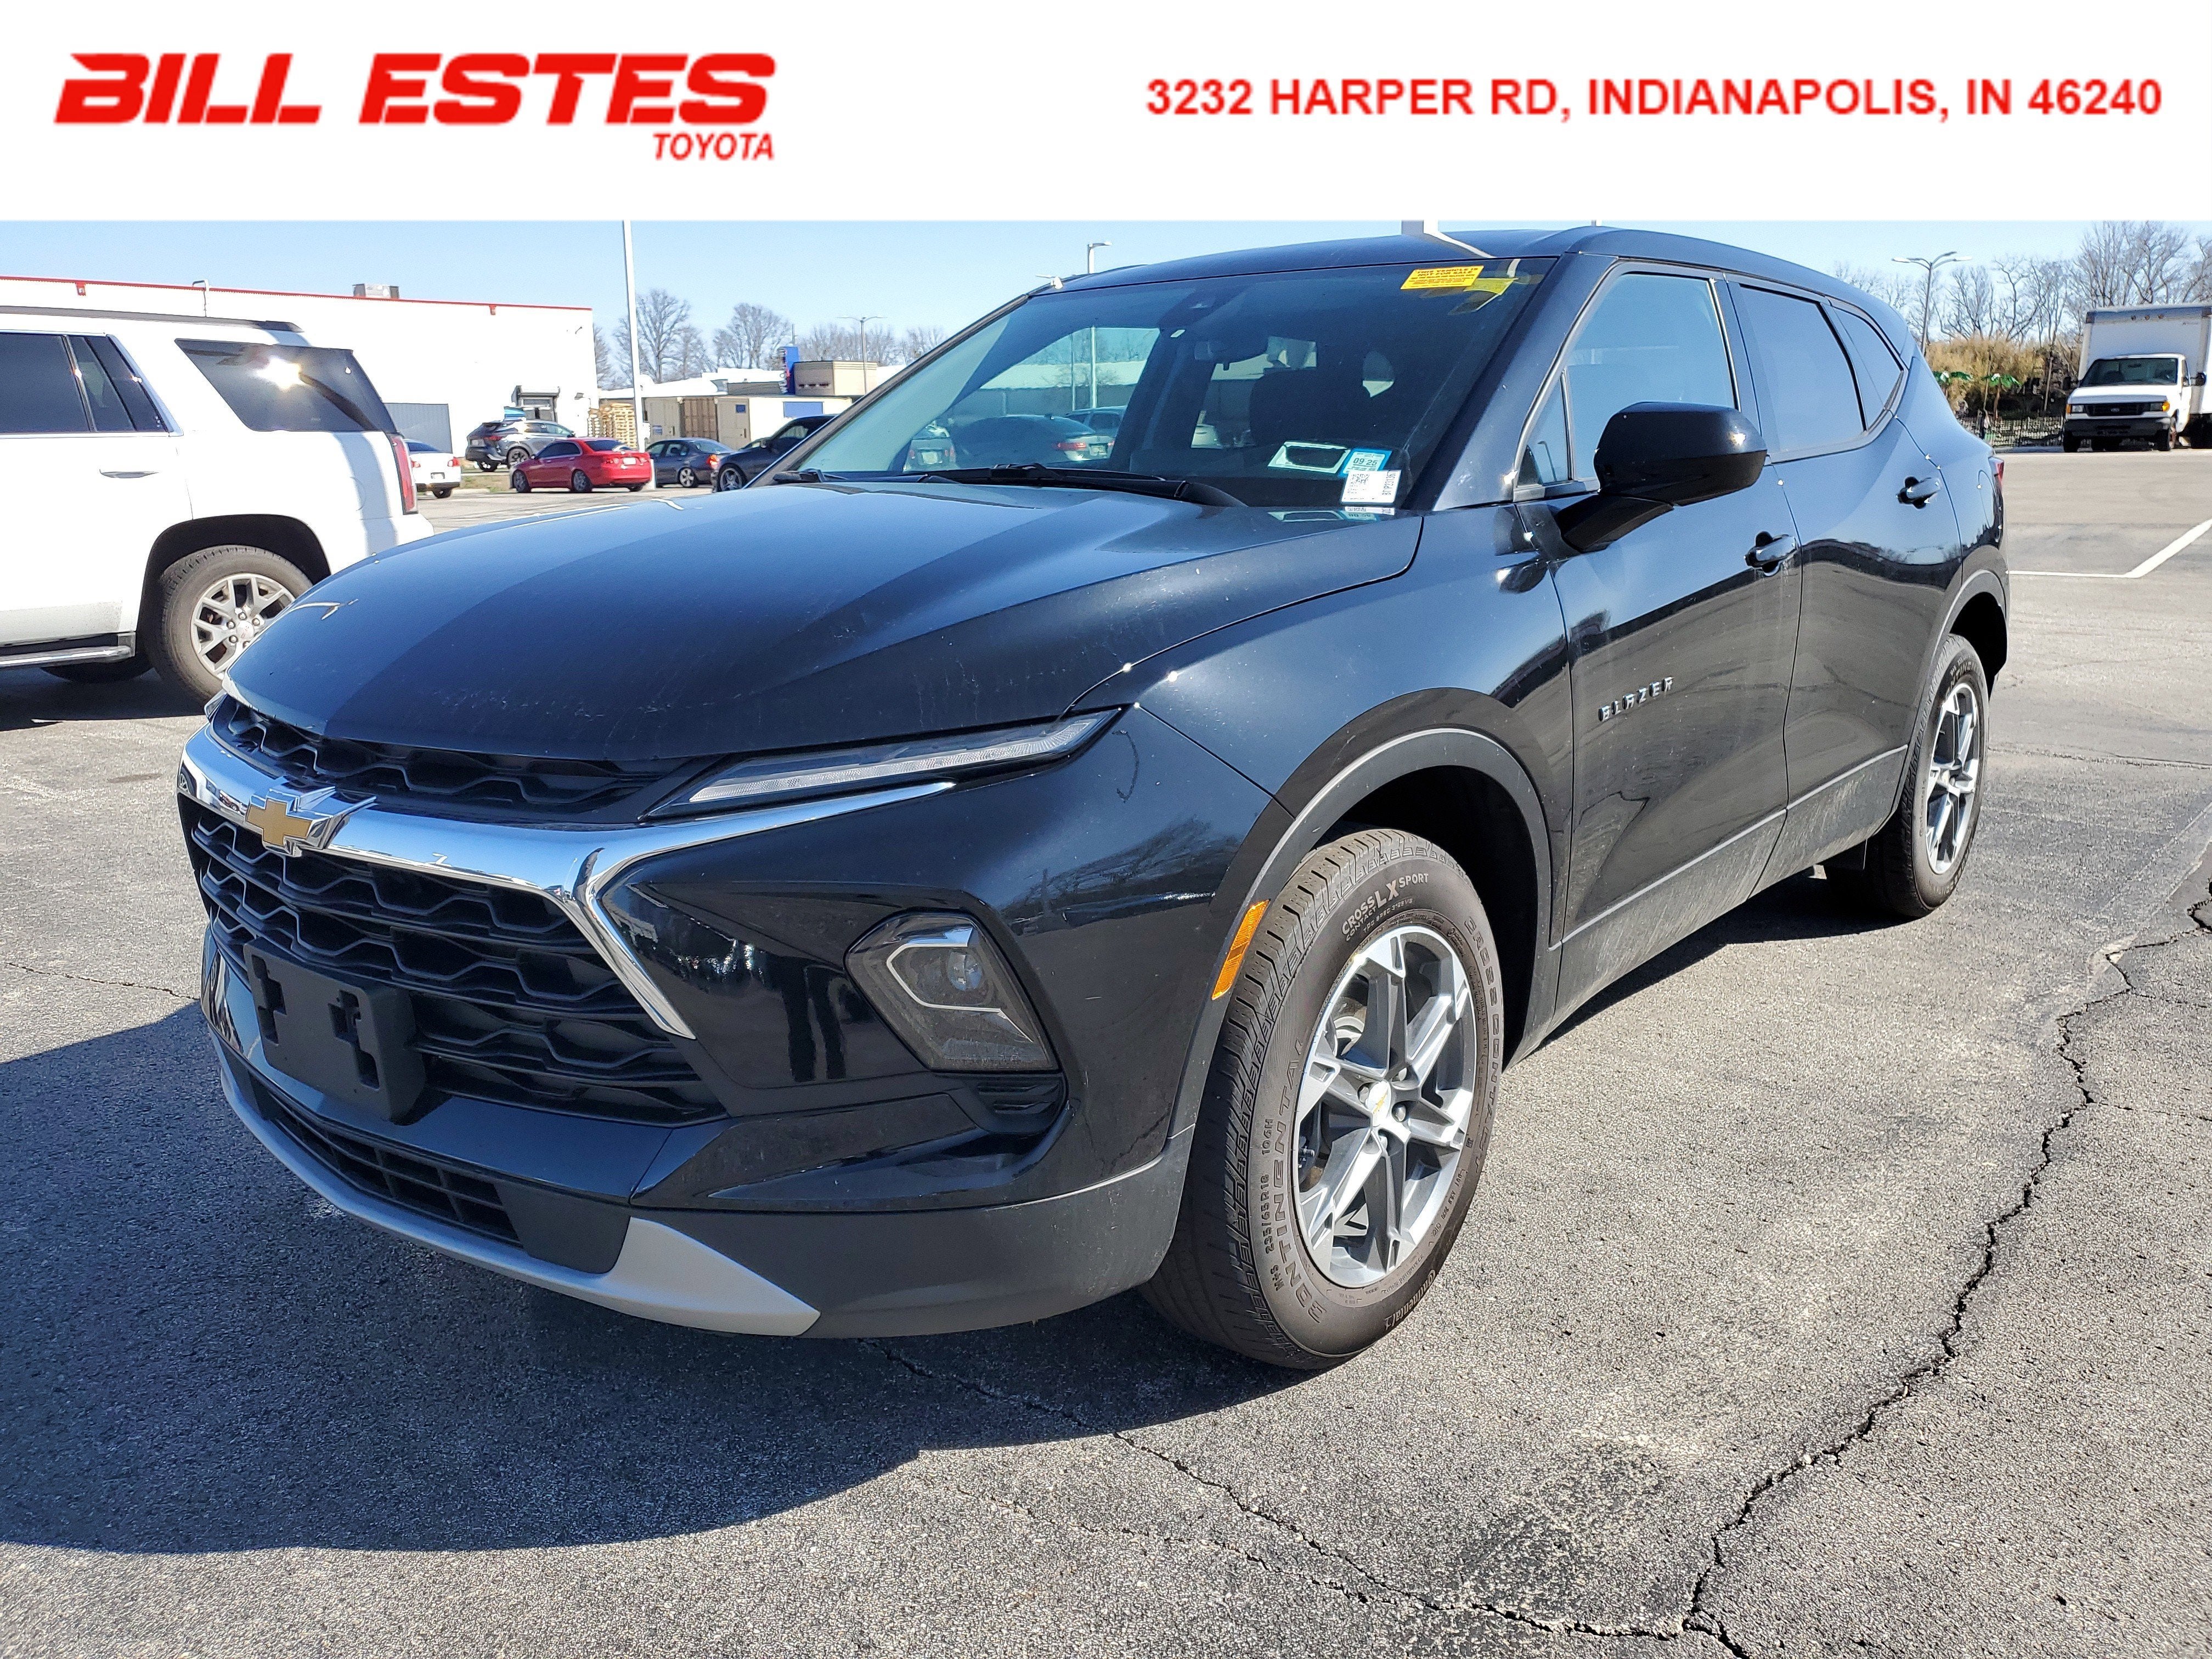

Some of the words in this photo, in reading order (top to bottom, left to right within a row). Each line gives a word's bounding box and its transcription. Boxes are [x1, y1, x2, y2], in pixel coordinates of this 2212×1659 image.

[1598, 675, 1675, 722] BLAZER
[1342, 896, 1375, 935] CROSS
[1374, 879, 1400, 909] LX
[1398, 873, 1429, 889] SPORT
[1346, 905, 1378, 942] CONTACT
[1261, 1118, 1273, 1155] 106H
[1260, 1173, 1274, 1254] 235/65R18
[1391, 1268, 1436, 1328] Continental
